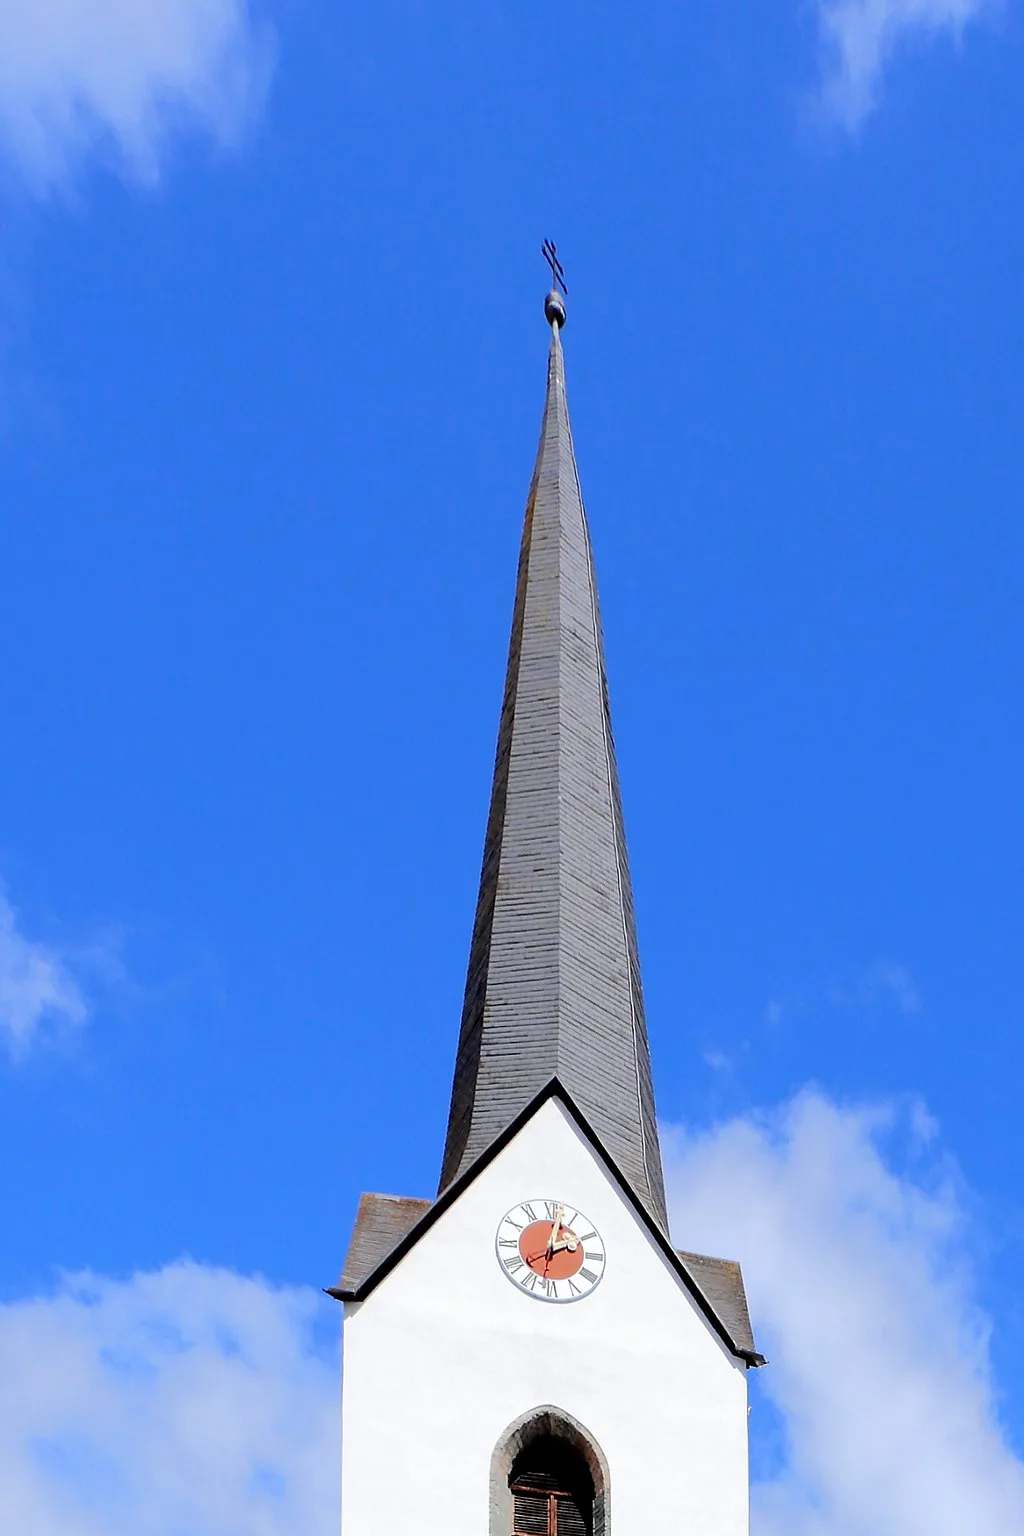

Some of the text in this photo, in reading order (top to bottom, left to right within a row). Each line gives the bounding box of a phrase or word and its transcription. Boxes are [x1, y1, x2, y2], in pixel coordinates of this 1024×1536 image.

[521, 1203, 537, 1222] XI
[568, 1213, 578, 1226] I
[505, 1216, 523, 1232] X
[499, 1237, 517, 1248] IX
[580, 1231, 597, 1241] II
[503, 1255, 524, 1275] VIII
[585, 1252, 603, 1262] III
[520, 1272, 537, 1290] VII
[546, 1280, 558, 1297] VI
[568, 1279, 581, 1296] V
